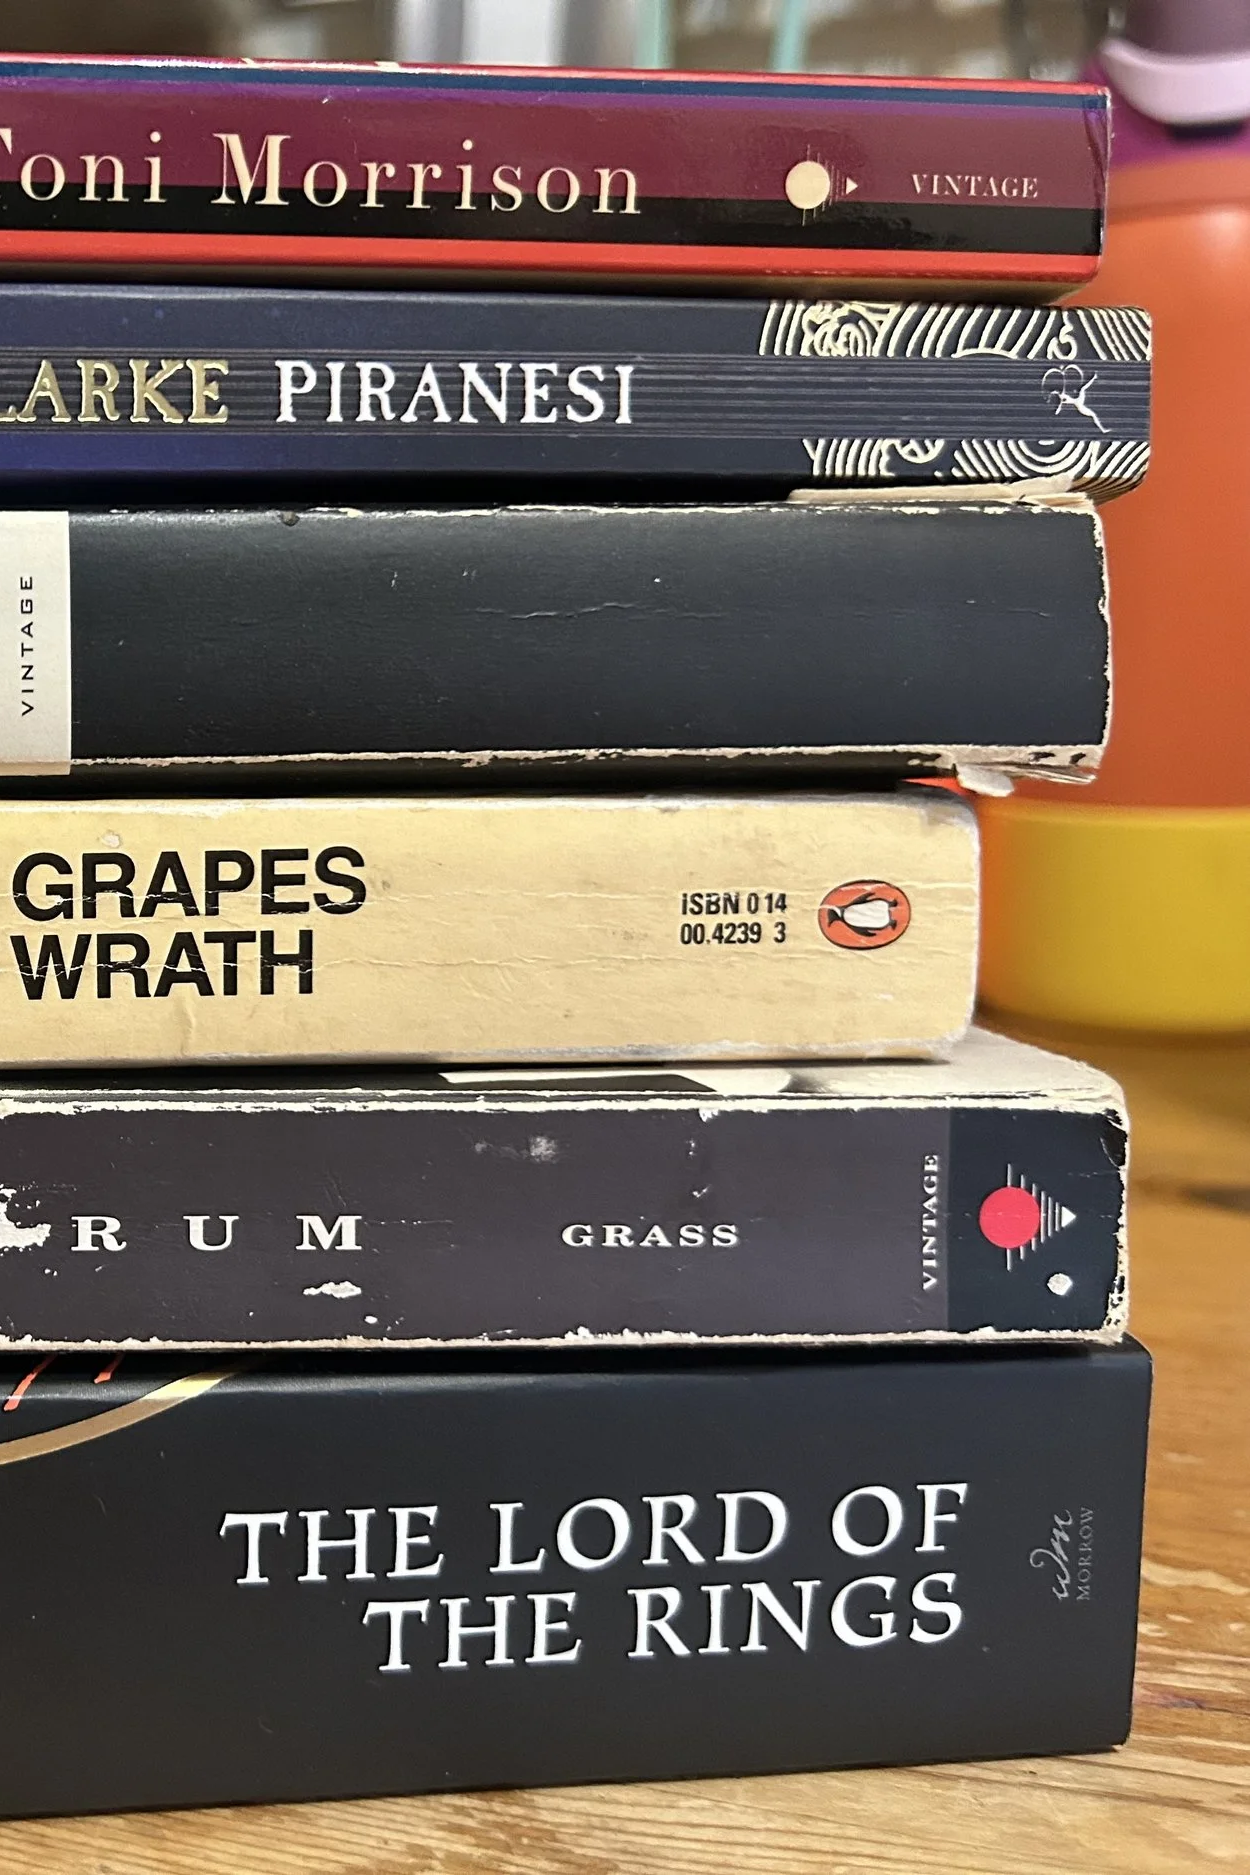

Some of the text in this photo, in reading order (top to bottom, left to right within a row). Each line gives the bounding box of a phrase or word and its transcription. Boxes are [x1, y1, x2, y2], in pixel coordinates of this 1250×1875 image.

[210, 132, 643, 217] Morrison
[910, 173, 1040, 200] VINTAGE
[274, 360, 636, 425] PIRANESI
[20, 575, 35, 717] VINTAGE
[11, 845, 368, 922] GRAPES
[681, 892, 741, 915] ISBN
[10, 928, 314, 1001] WRATH
[773, 920, 787, 944] 3
[561, 1222, 741, 1249] GRASS
[922, 1153, 940, 1291] VINTAGE
[219, 1481, 970, 1586] THE LORD OF
[1076, 1507, 1094, 1601] MORROW
[363, 1571, 965, 1673] THE RINGS
